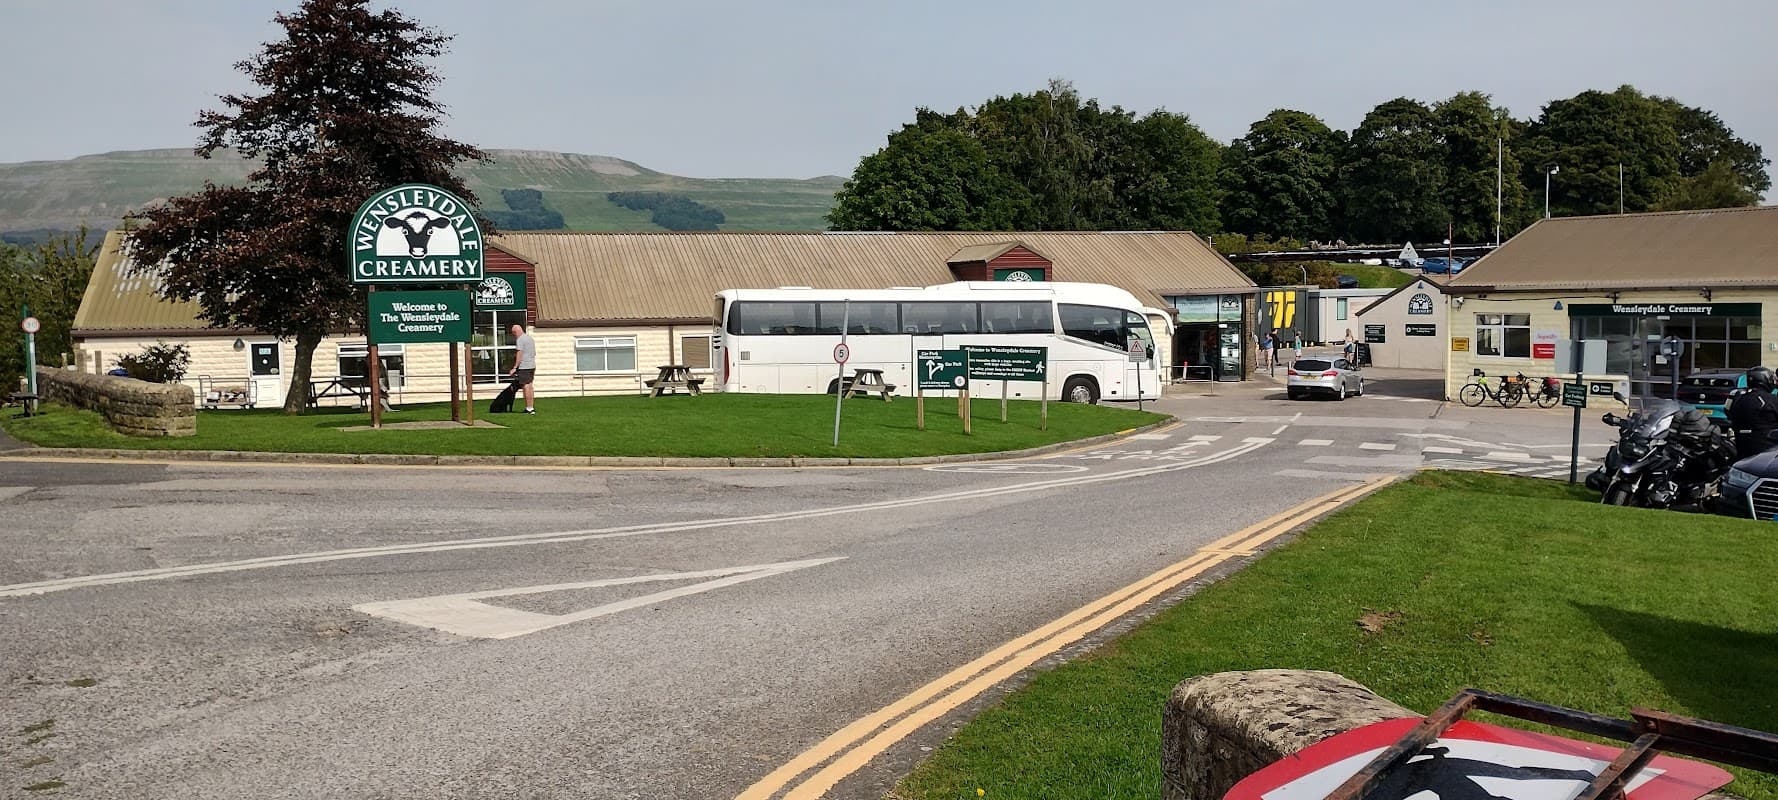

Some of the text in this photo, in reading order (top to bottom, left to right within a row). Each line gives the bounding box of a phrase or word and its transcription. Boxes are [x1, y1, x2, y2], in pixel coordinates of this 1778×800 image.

[357, 190, 478, 251] WENSLEYDALE
[359, 260, 478, 276] CREAMERY
[392, 302, 447, 312] Welcome to
[1612, 304, 1713, 315] Wensleydale Creamery
[380, 312, 460, 324] The Wensleydale
[398, 323, 444, 333] Creamery
[839, 349, 844, 358] 5
